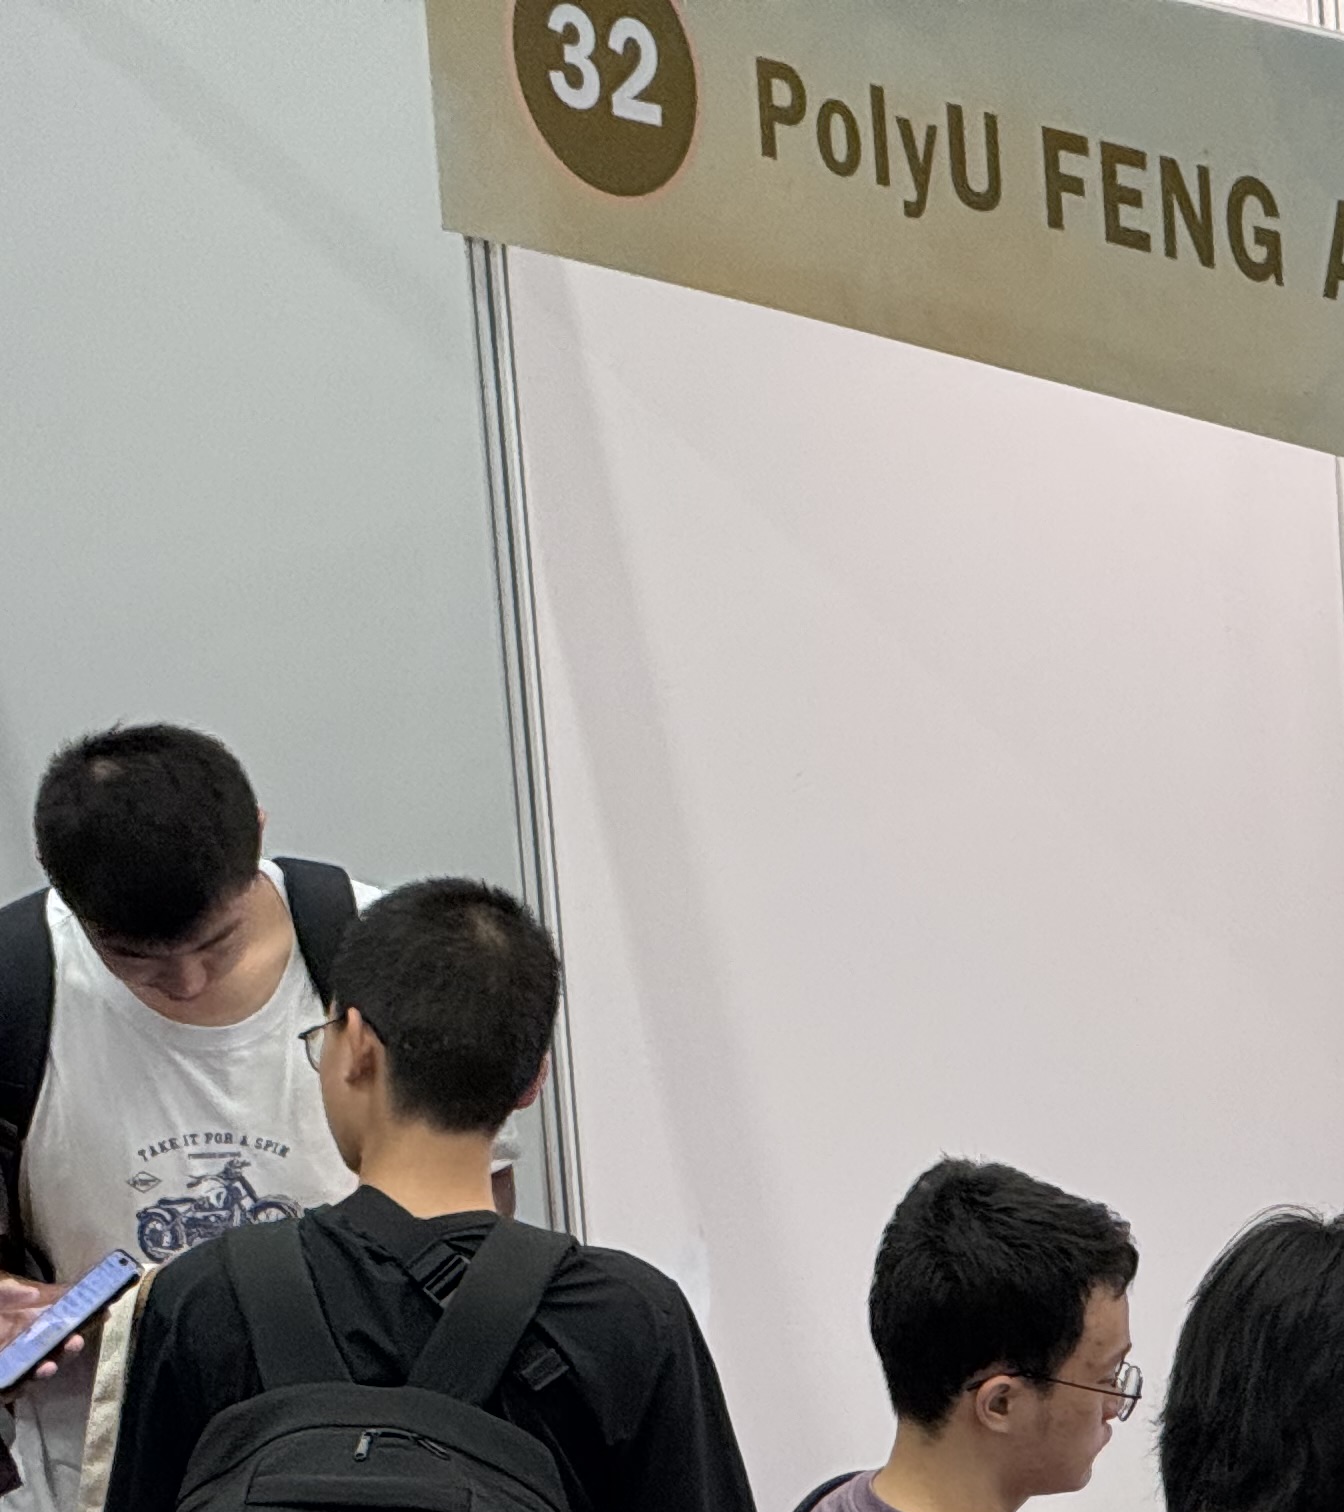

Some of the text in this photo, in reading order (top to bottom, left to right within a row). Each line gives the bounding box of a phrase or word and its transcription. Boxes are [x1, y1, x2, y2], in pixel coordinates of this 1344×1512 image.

[548, 2, 662, 127] 32
[755, 55, 1002, 217] PolyU
[1041, 125, 1284, 287] FENG
[137, 1137, 180, 1162] TAKE
[183, 1133, 199, 1147] IT
[204, 1132, 233, 1145] FOR
[239, 1134, 250, 1147] A
[254, 1137, 291, 1158] SPIN
